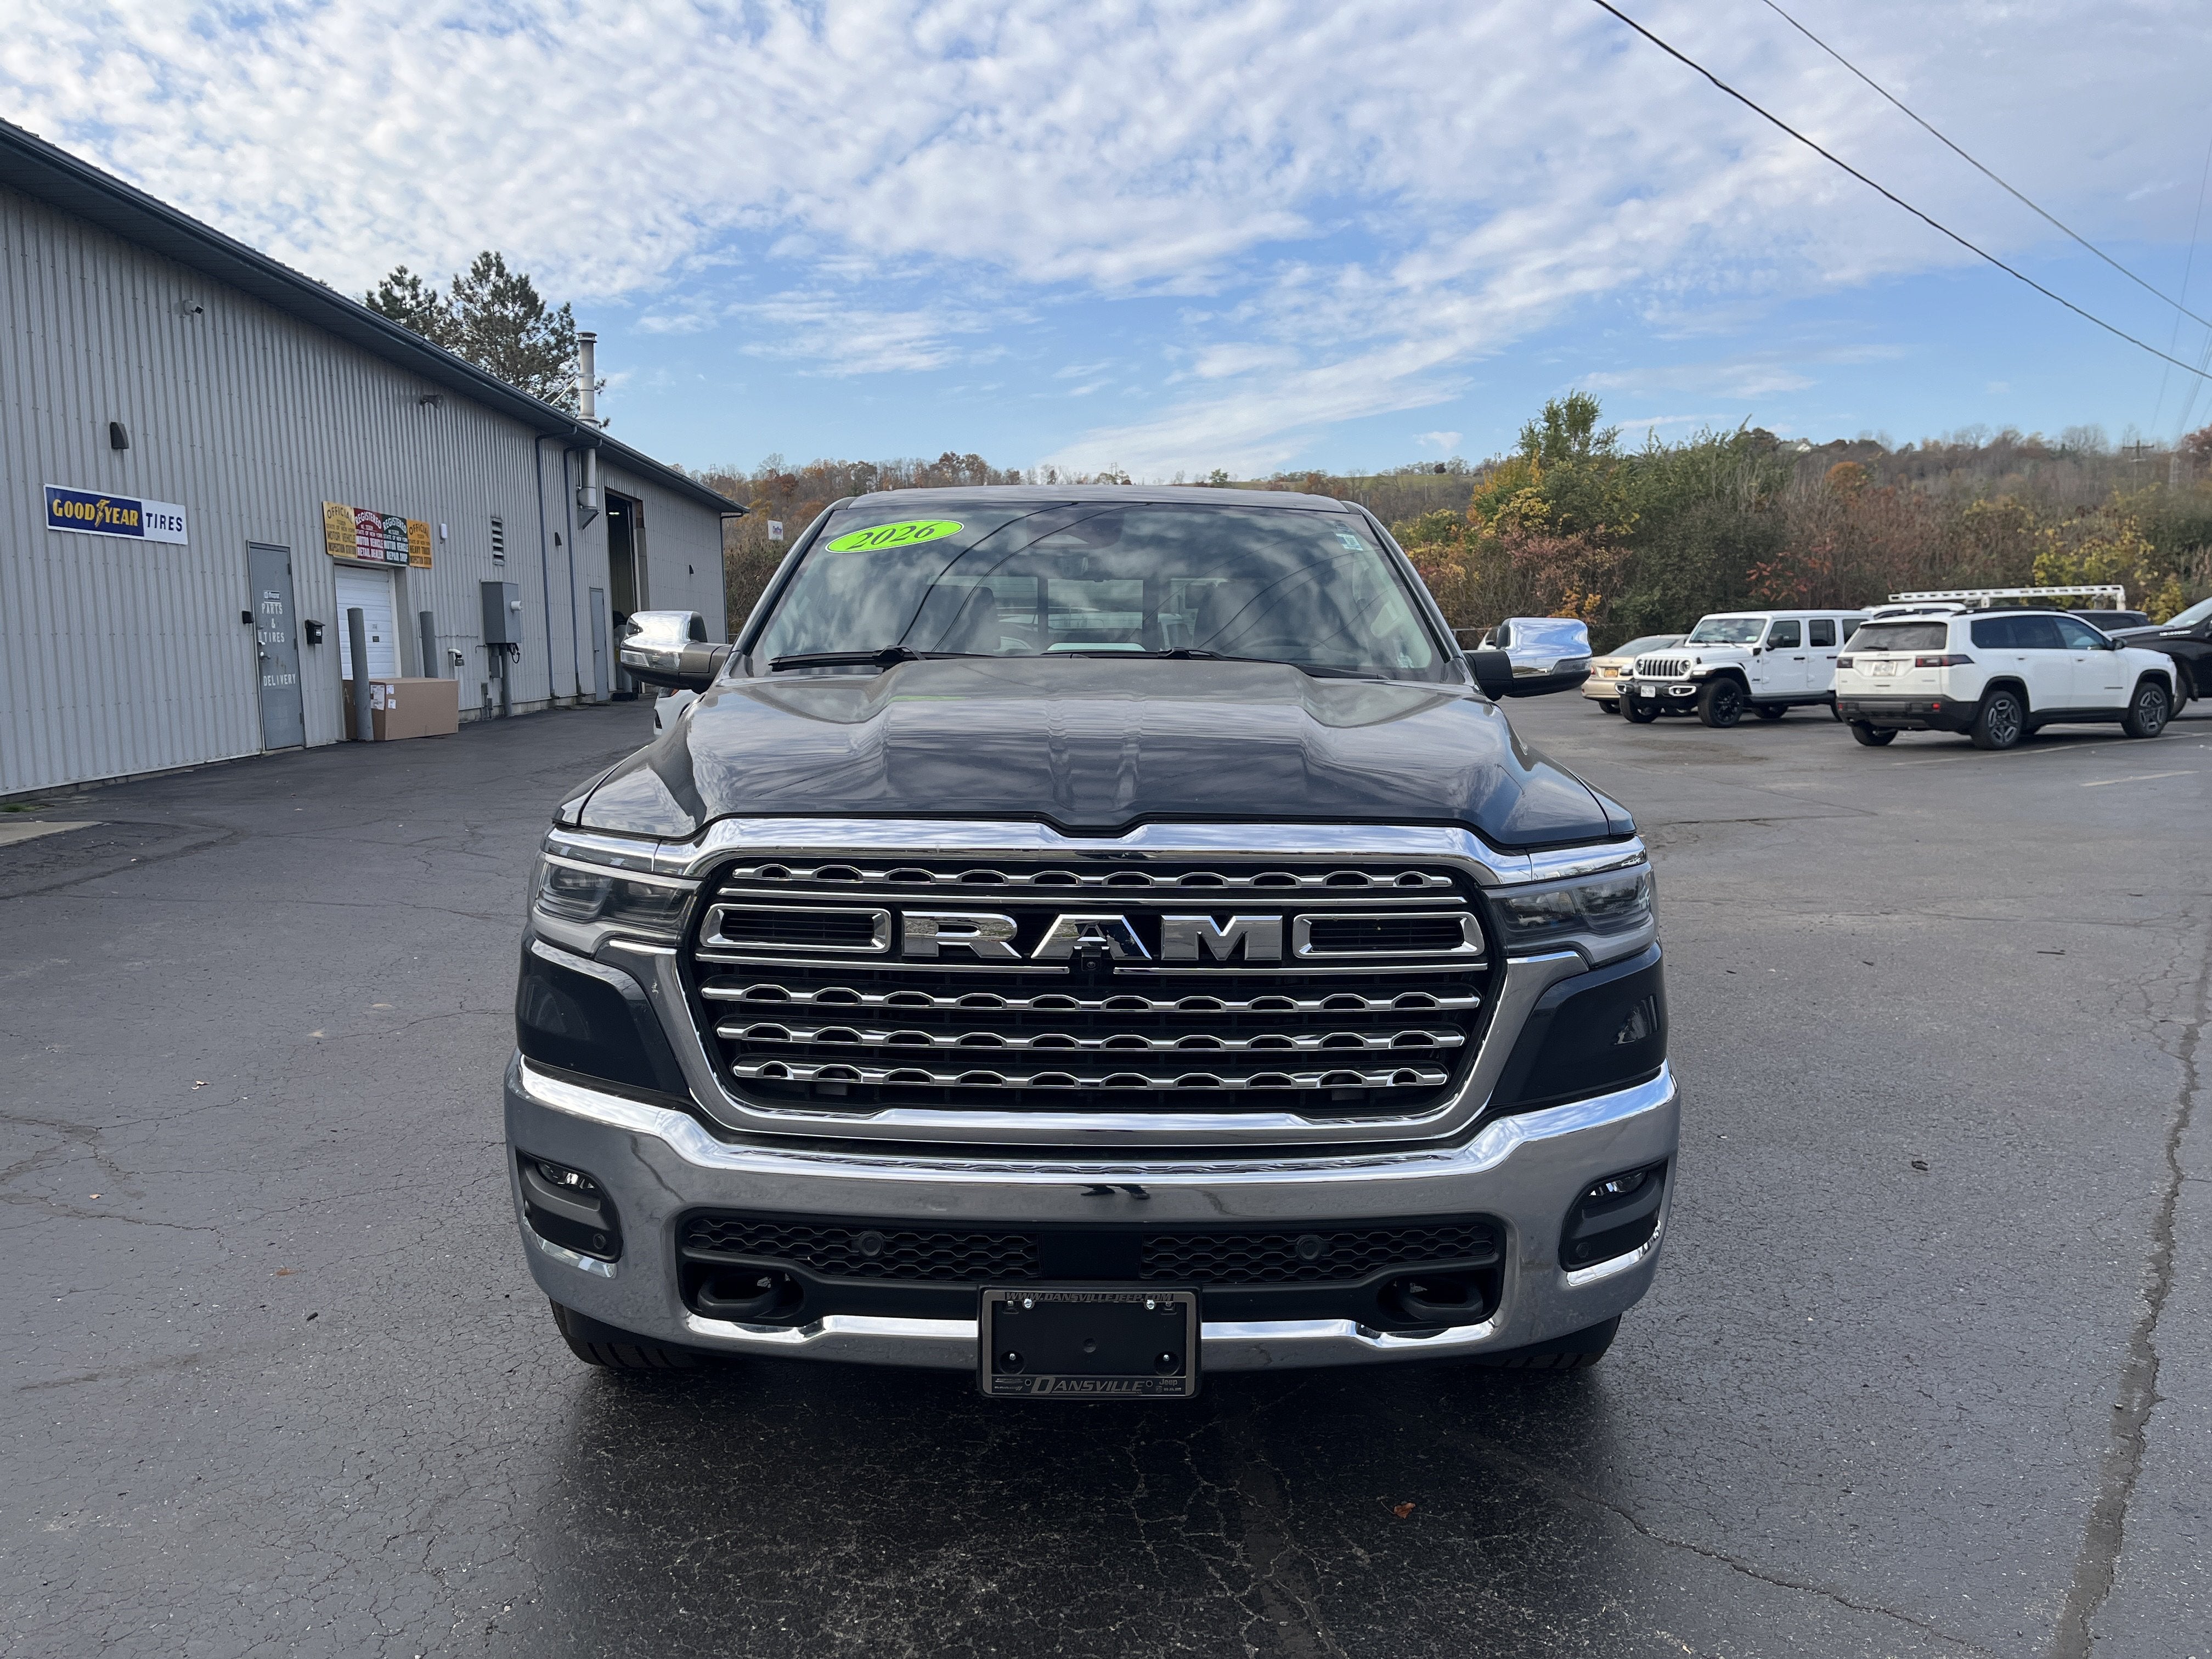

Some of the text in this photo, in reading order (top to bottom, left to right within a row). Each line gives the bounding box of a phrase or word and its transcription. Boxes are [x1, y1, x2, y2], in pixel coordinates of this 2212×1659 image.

[53, 499, 183, 532] GOODYEAR TIRES
[327, 506, 353, 524] OFFICIAL
[354, 511, 382, 530] REGISTERED
[382, 517, 407, 534] REGISTERED
[409, 523, 429, 538] OFFICIAL
[845, 522, 943, 550] 2026
[410, 545, 420, 554] HEAVY
[262, 602, 283, 615] PARTS
[271, 618, 276, 629] &
[263, 632, 285, 643] TIRES
[263, 673, 296, 686] DELIVERY
[901, 911, 1283, 961] RAM
[1006, 1291, 1174, 1302] WWW.DANSVILLEJEEP.COM
[1030, 1376, 1146, 1395] DANSVILLE
[1159, 1378, 1178, 1386] Jeep
